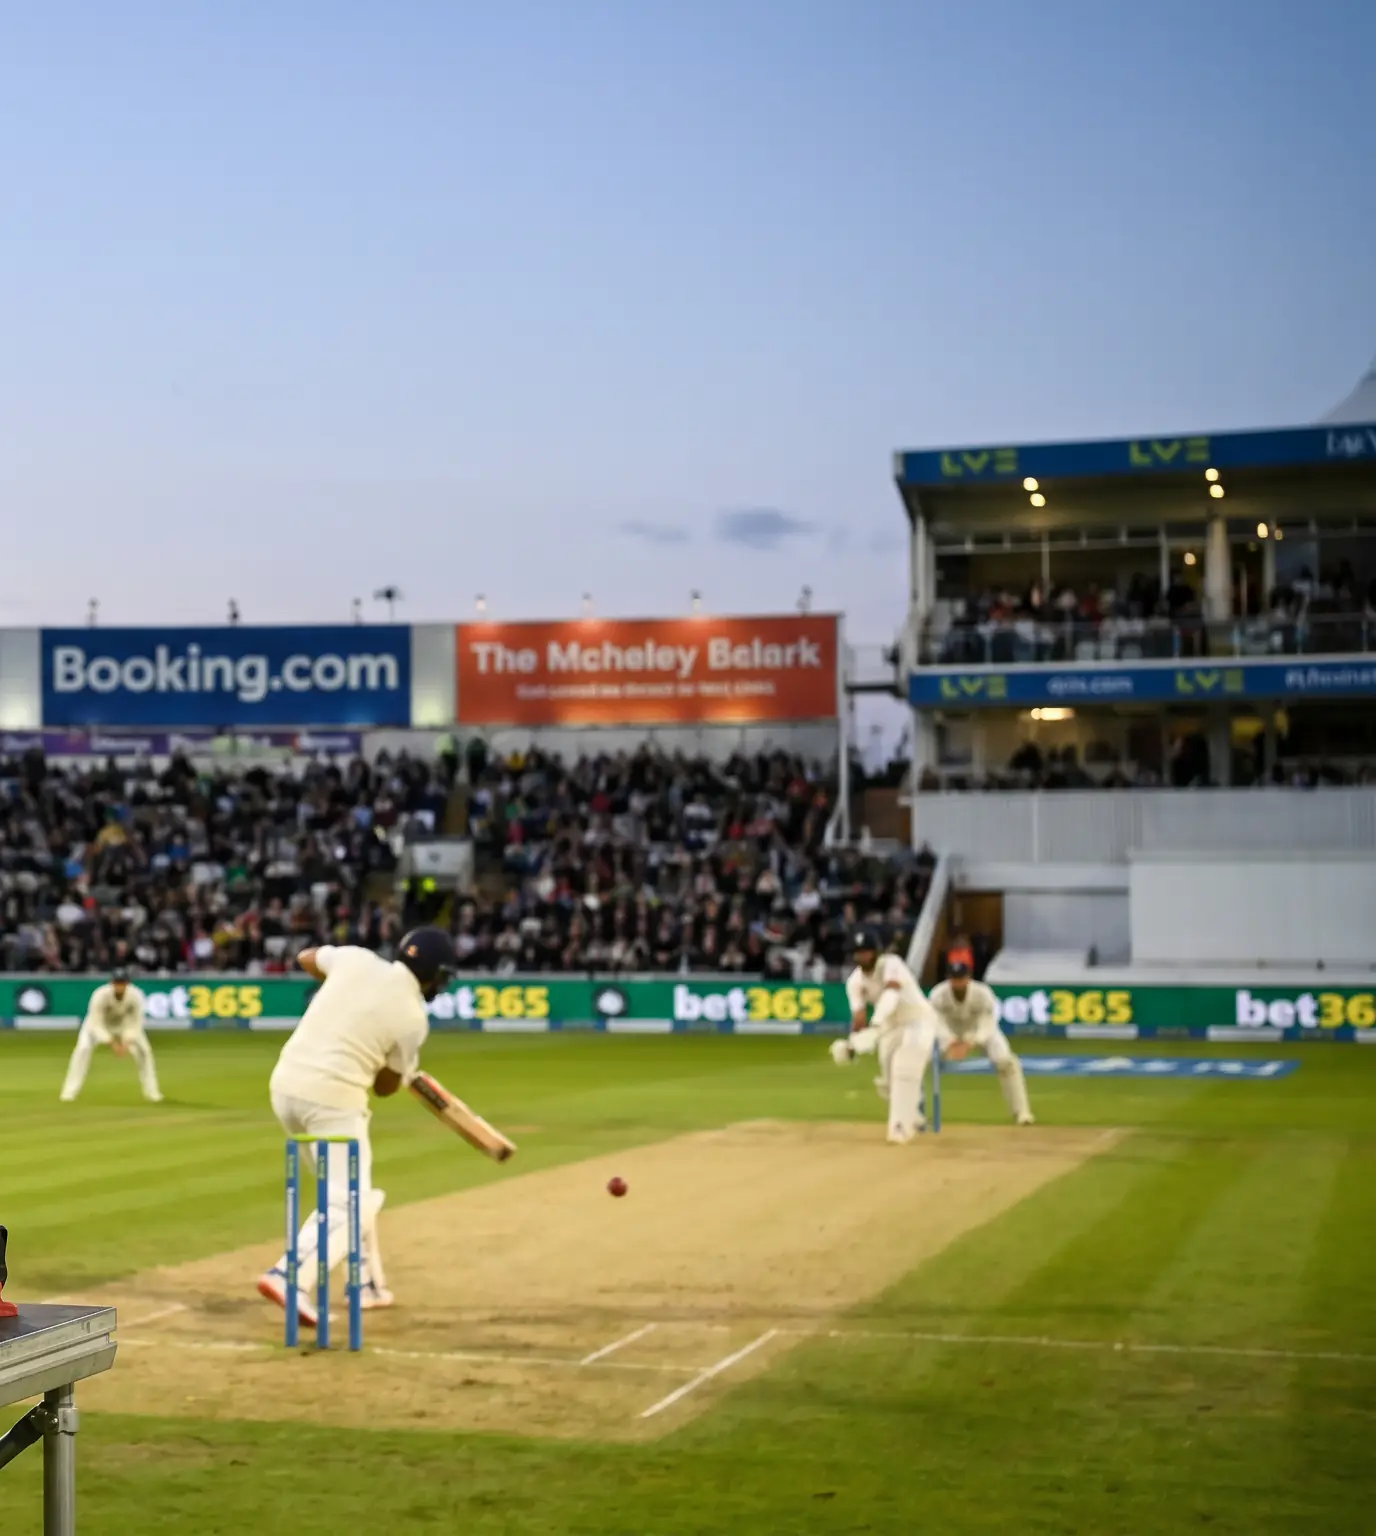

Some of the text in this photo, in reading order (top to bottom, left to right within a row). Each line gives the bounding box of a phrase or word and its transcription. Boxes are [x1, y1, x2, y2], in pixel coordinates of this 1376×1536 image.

[53, 643, 399, 703] Booking.com
[470, 641, 537, 674] The
[145, 985, 263, 1018] et365
[425, 985, 550, 1019] et365
[674, 984, 824, 1021] bet365
[995, 989, 1132, 1025] et365
